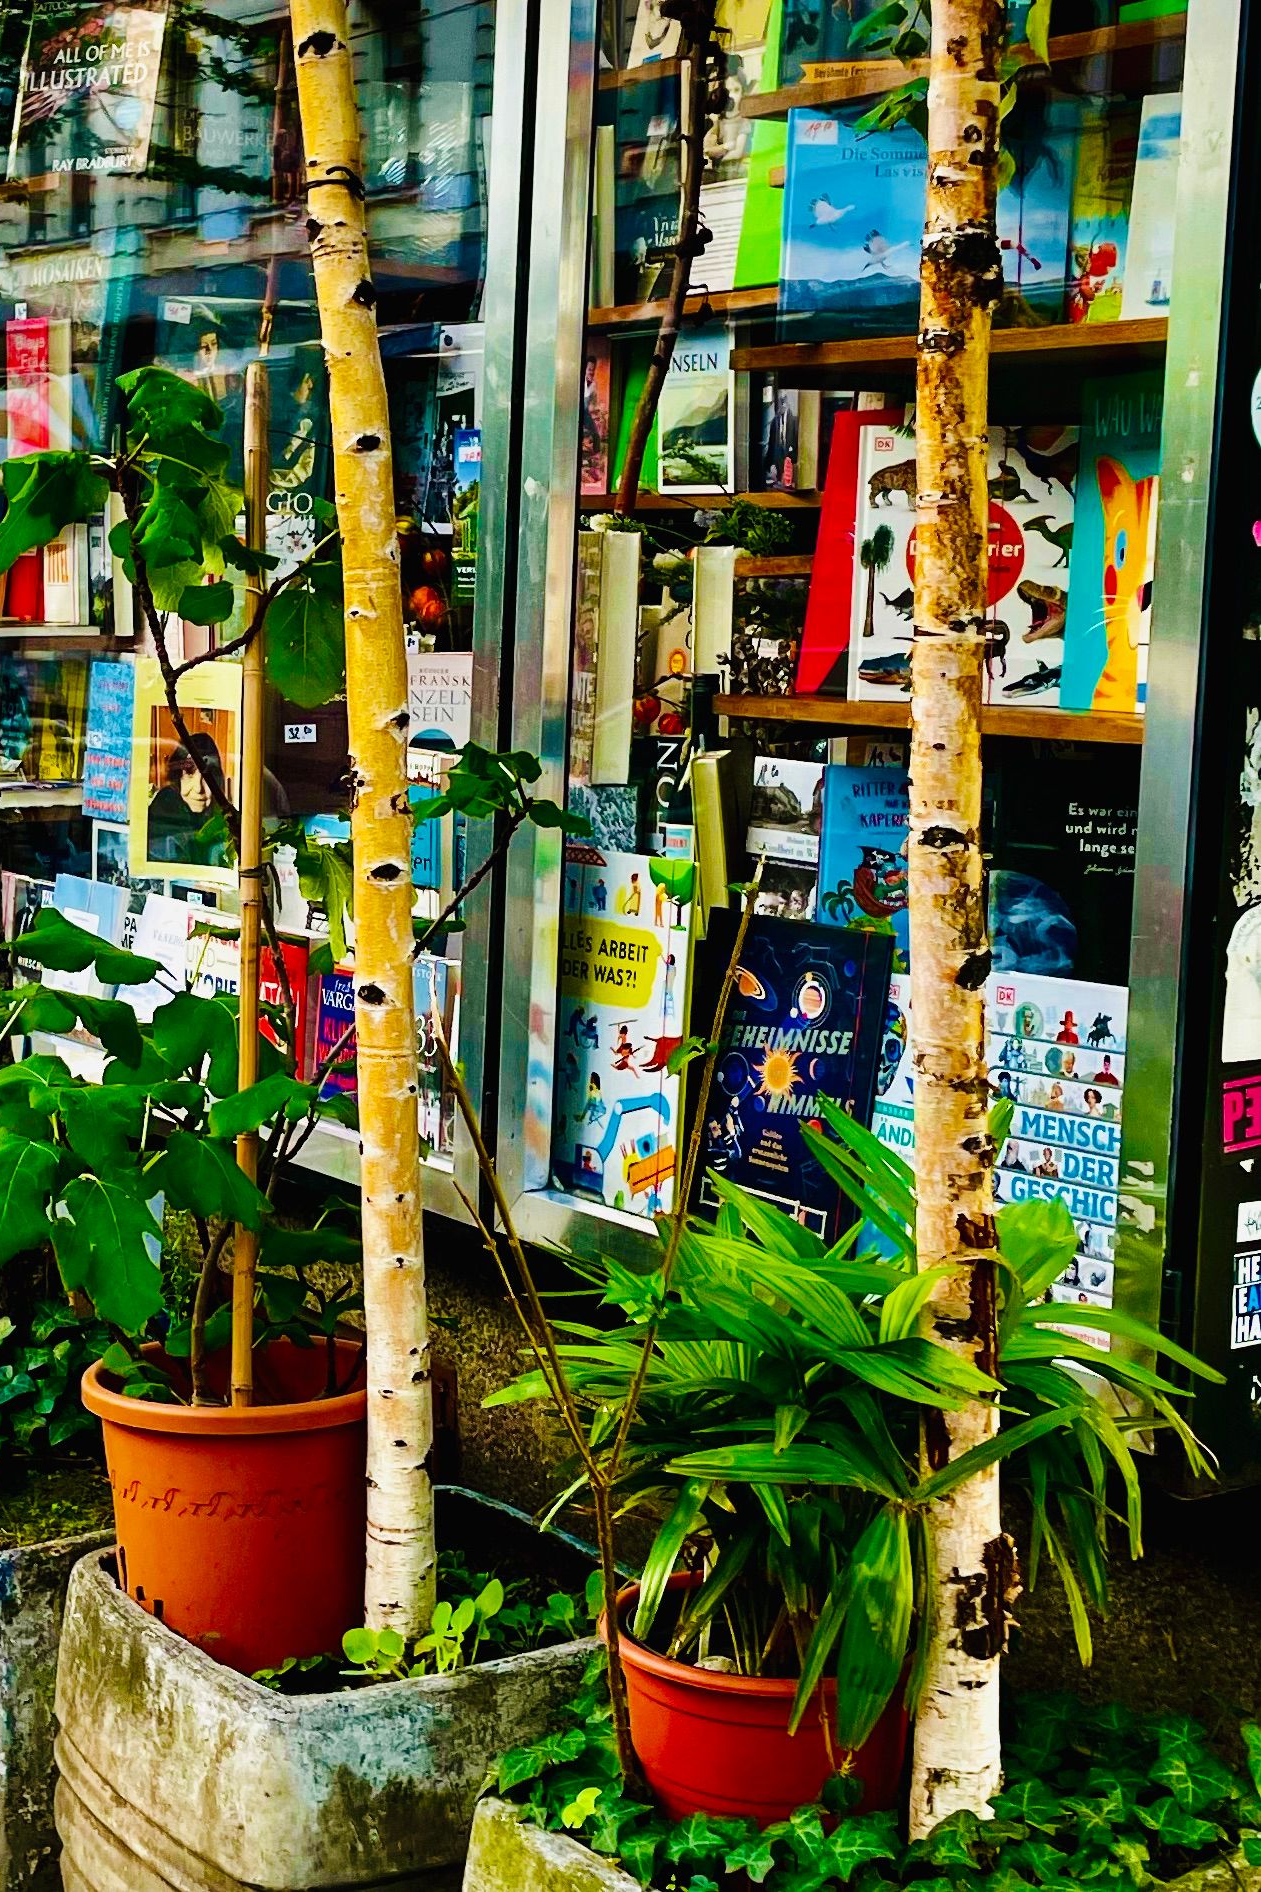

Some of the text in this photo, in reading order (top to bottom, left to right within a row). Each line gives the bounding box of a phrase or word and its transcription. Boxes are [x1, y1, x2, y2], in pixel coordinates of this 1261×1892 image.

[54, 41, 150, 64] ALL OF ME IS
[25, 64, 148, 91] ILLUSTRATED
[842, 148, 867, 161] Die
[52, 155, 133, 172] RAY BRADBURY
[875, 164, 899, 178] Las
[877, 440, 891, 448] DK
[411, 707, 454, 722] SEIN
[852, 782, 895, 798] RITTER
[1068, 802, 1084, 816] Es
[1089, 808, 1112, 817] war
[1066, 821, 1092, 834] und
[1097, 822, 1127, 835] wird
[1080, 838, 1117, 857] lange
[598, 938, 649, 963] ARBEIT
[562, 959, 637, 989] DER WAS?!
[998, 990, 1013, 1001] DK
[766, 1093, 855, 1119] HIMMS
[1063, 1151, 1115, 1188] DER
[1010, 1176, 1115, 1222] GESCHIC
